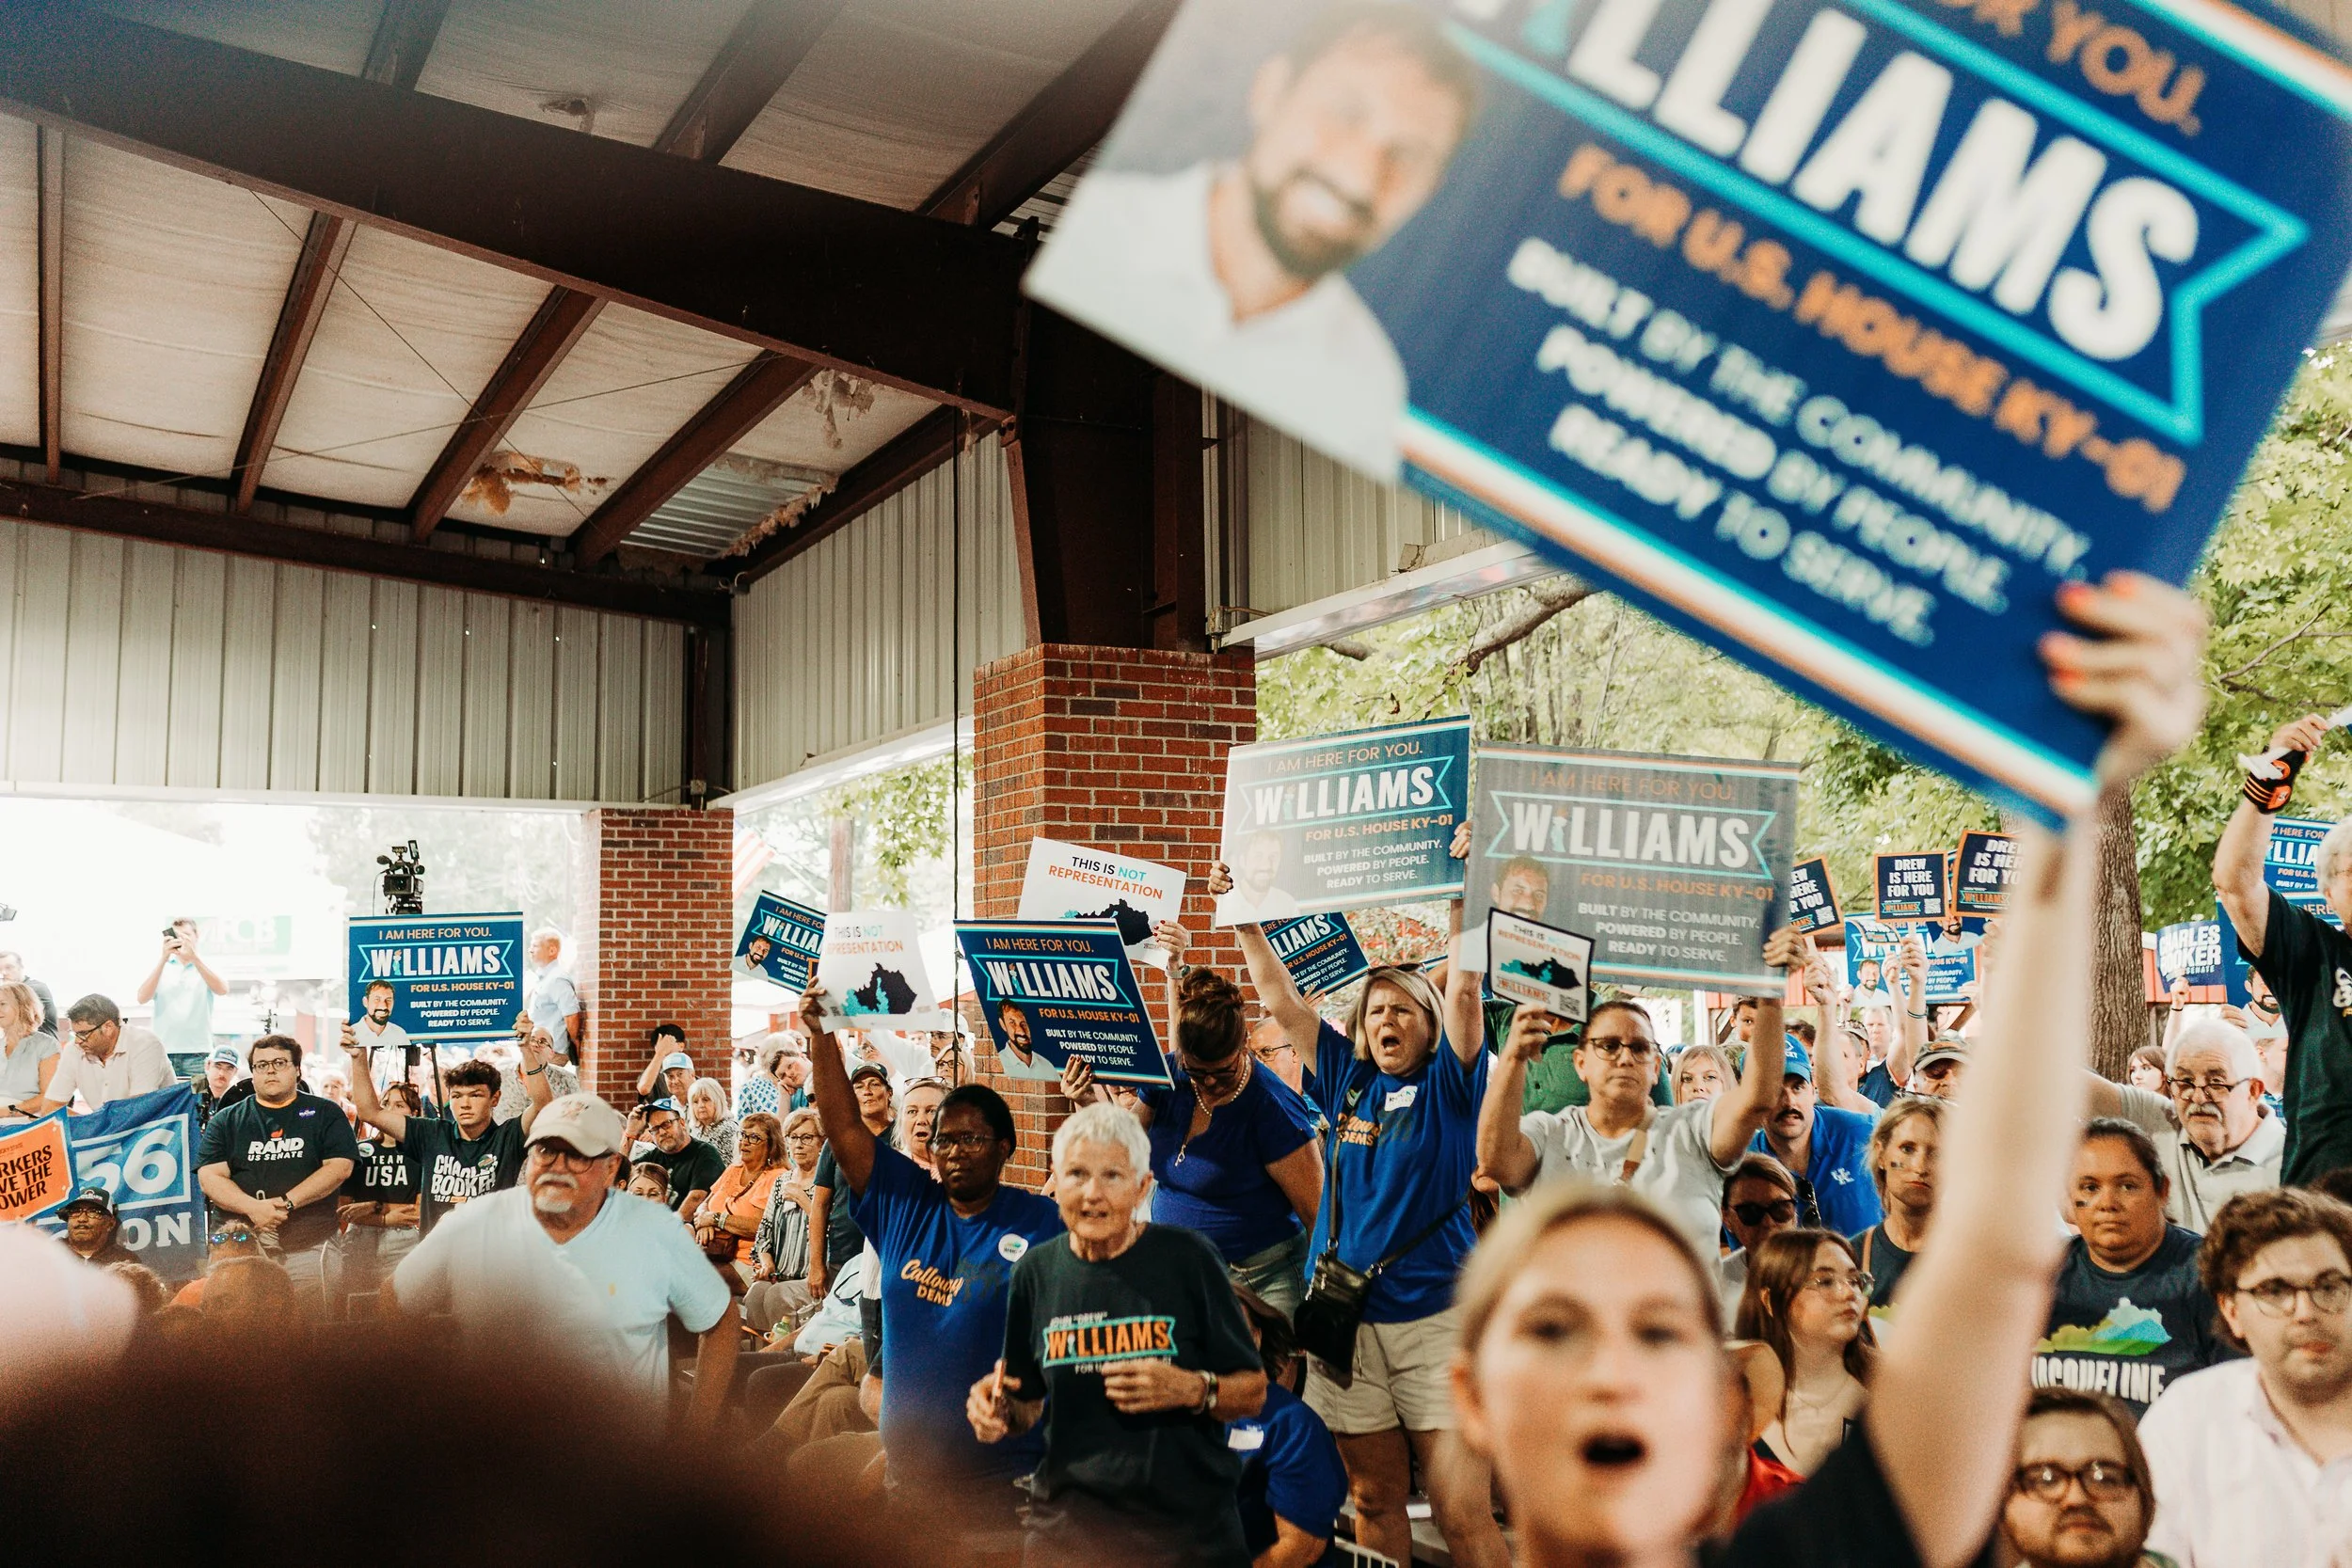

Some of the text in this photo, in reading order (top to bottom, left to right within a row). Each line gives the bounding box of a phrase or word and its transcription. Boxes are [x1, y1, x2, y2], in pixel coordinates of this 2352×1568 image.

[1449, 0, 2199, 360] LLIAMS
[1276, 741, 1422, 772] AM HERE FOR YOU.
[1539, 772, 1575, 788] AM
[1582, 773, 1631, 793] HERE
[1639, 778, 1681, 797] FOR
[1255, 767, 1433, 825] WILLIAMS
[1306, 814, 1453, 842] FOR U.S. HOUSE KY-01
[1513, 802, 1749, 868] WILLIAMS
[2280, 828, 2303, 837] HERE
[1304, 839, 1442, 863] BUILT BY THE COMMUNITY.
[1974, 852, 2024, 867] IS HER
[2266, 840, 2320, 865] LLIA
[1072, 857, 1147, 881] THIS IS NOT
[1317, 854, 1429, 876] POWERED BY PEOPLE.
[1895, 858, 1926, 871] DREW
[2279, 868, 2295, 877] FOR
[1049, 864, 1163, 899] REPRESENTATION
[1327, 870, 1417, 888] READY TO SERVE.
[1889, 871, 1932, 883] IS HERE
[1968, 867, 1998, 883] FOR
[1580, 873, 1774, 901] FOR U.S. HOUSE KY-01
[1887, 883, 1934, 897] FOR YOU
[1799, 893, 1823, 910] YOU
[780, 908, 810, 925] AM HERE
[1578, 902, 1760, 928] BUILT BY THE COMMUNITY.
[379, 927, 492, 940] I AM HERE FOR YOU.
[762, 915, 822, 955] WILLIA
[835, 927, 850, 937] THIS
[853, 927, 861, 937] IS
[1596, 921, 1742, 945] POWERED BY PEOPLE.
[781, 947, 805, 961] FOR U.S.
[986, 938, 1094, 953] I AM HERE FOR YOU.
[1294, 934, 1348, 967] U.S. HOUSE KY-01
[1608, 941, 1727, 962] READY TO SERVE.
[371, 945, 501, 976] WILLIAMS
[2186, 965, 2215, 974] SENATE
[411, 981, 515, 992] FOR U.S. HOUSE KY-01
[986, 961, 1117, 1001] WILLIAMS
[459, 998, 508, 1006] COMMUNITY.
[1039, 1008, 1140, 1023] FOR U.S. HOUSE KY-01
[1045, 1028, 1141, 1043] BUILT BY THE COMMUNITY.
[1059, 1041, 1136, 1054] POWERED BY PEOPLE.
[1097, 1054, 1107, 1064] TO
[1109, 1055, 1134, 1067] SERVE.
[247, 1137, 305, 1154] RAND
[263, 1150, 303, 1161] SENATE
[372, 1155, 404, 1164] TEAM
[365, 1165, 408, 1187] USA
[431, 1172, 496, 1196] BOOKER
[916, 1285, 953, 1307] DEMS
[1049, 1321, 1170, 1359] WILLIAMS
[1074, 1364, 1094, 1375] FOR
